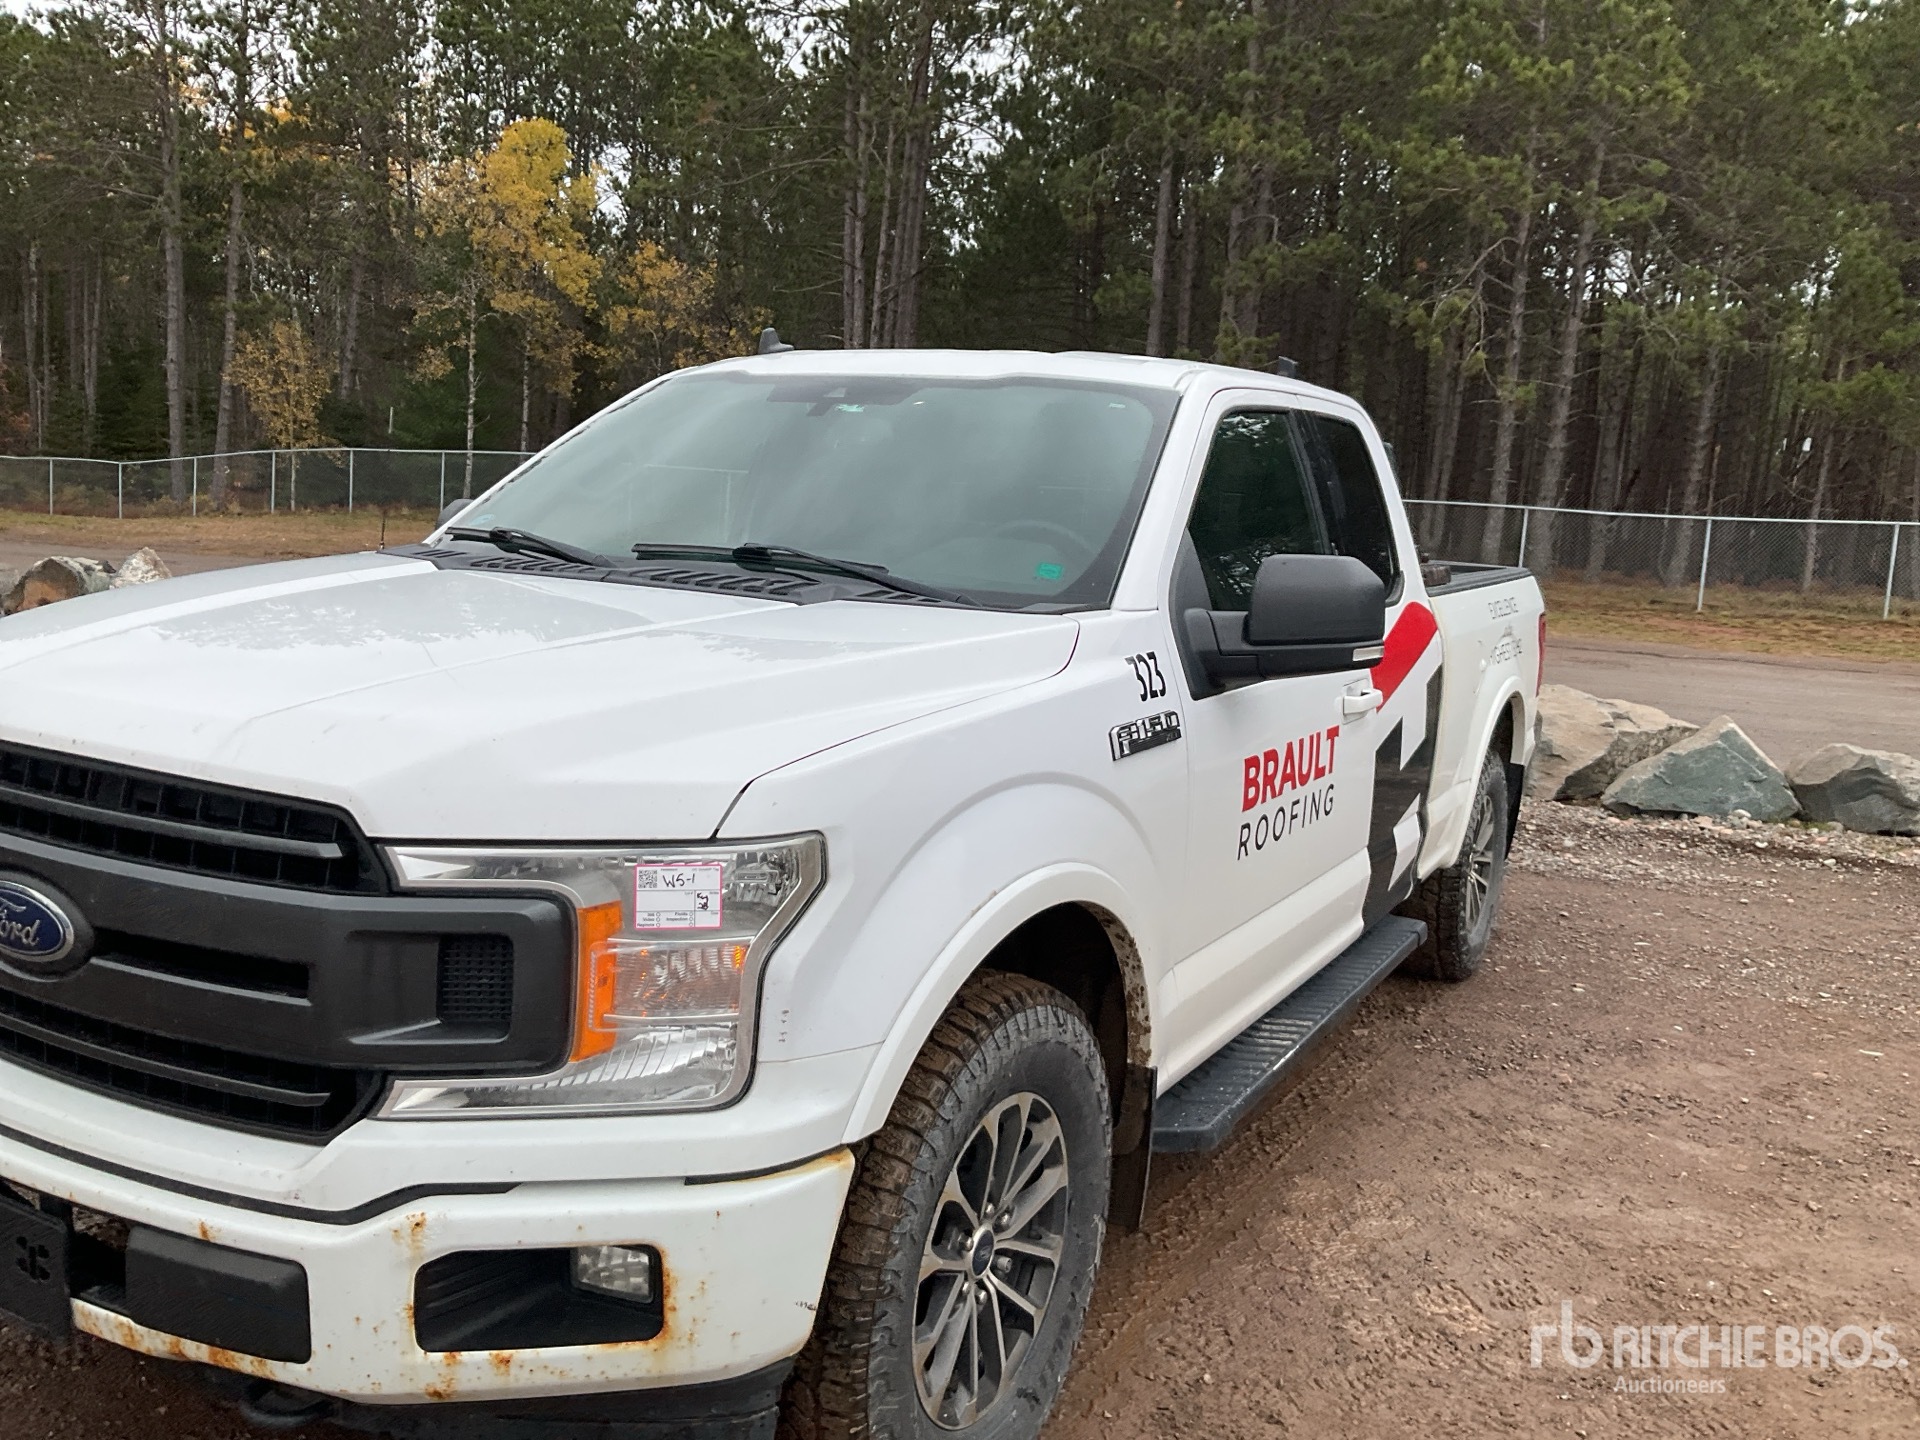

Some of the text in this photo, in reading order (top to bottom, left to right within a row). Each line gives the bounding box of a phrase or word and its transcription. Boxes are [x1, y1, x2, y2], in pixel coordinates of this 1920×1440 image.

[1124, 651, 1166, 702] 323
[1242, 725, 1339, 812] BRAULT
[1237, 783, 1334, 861] ROOFING
